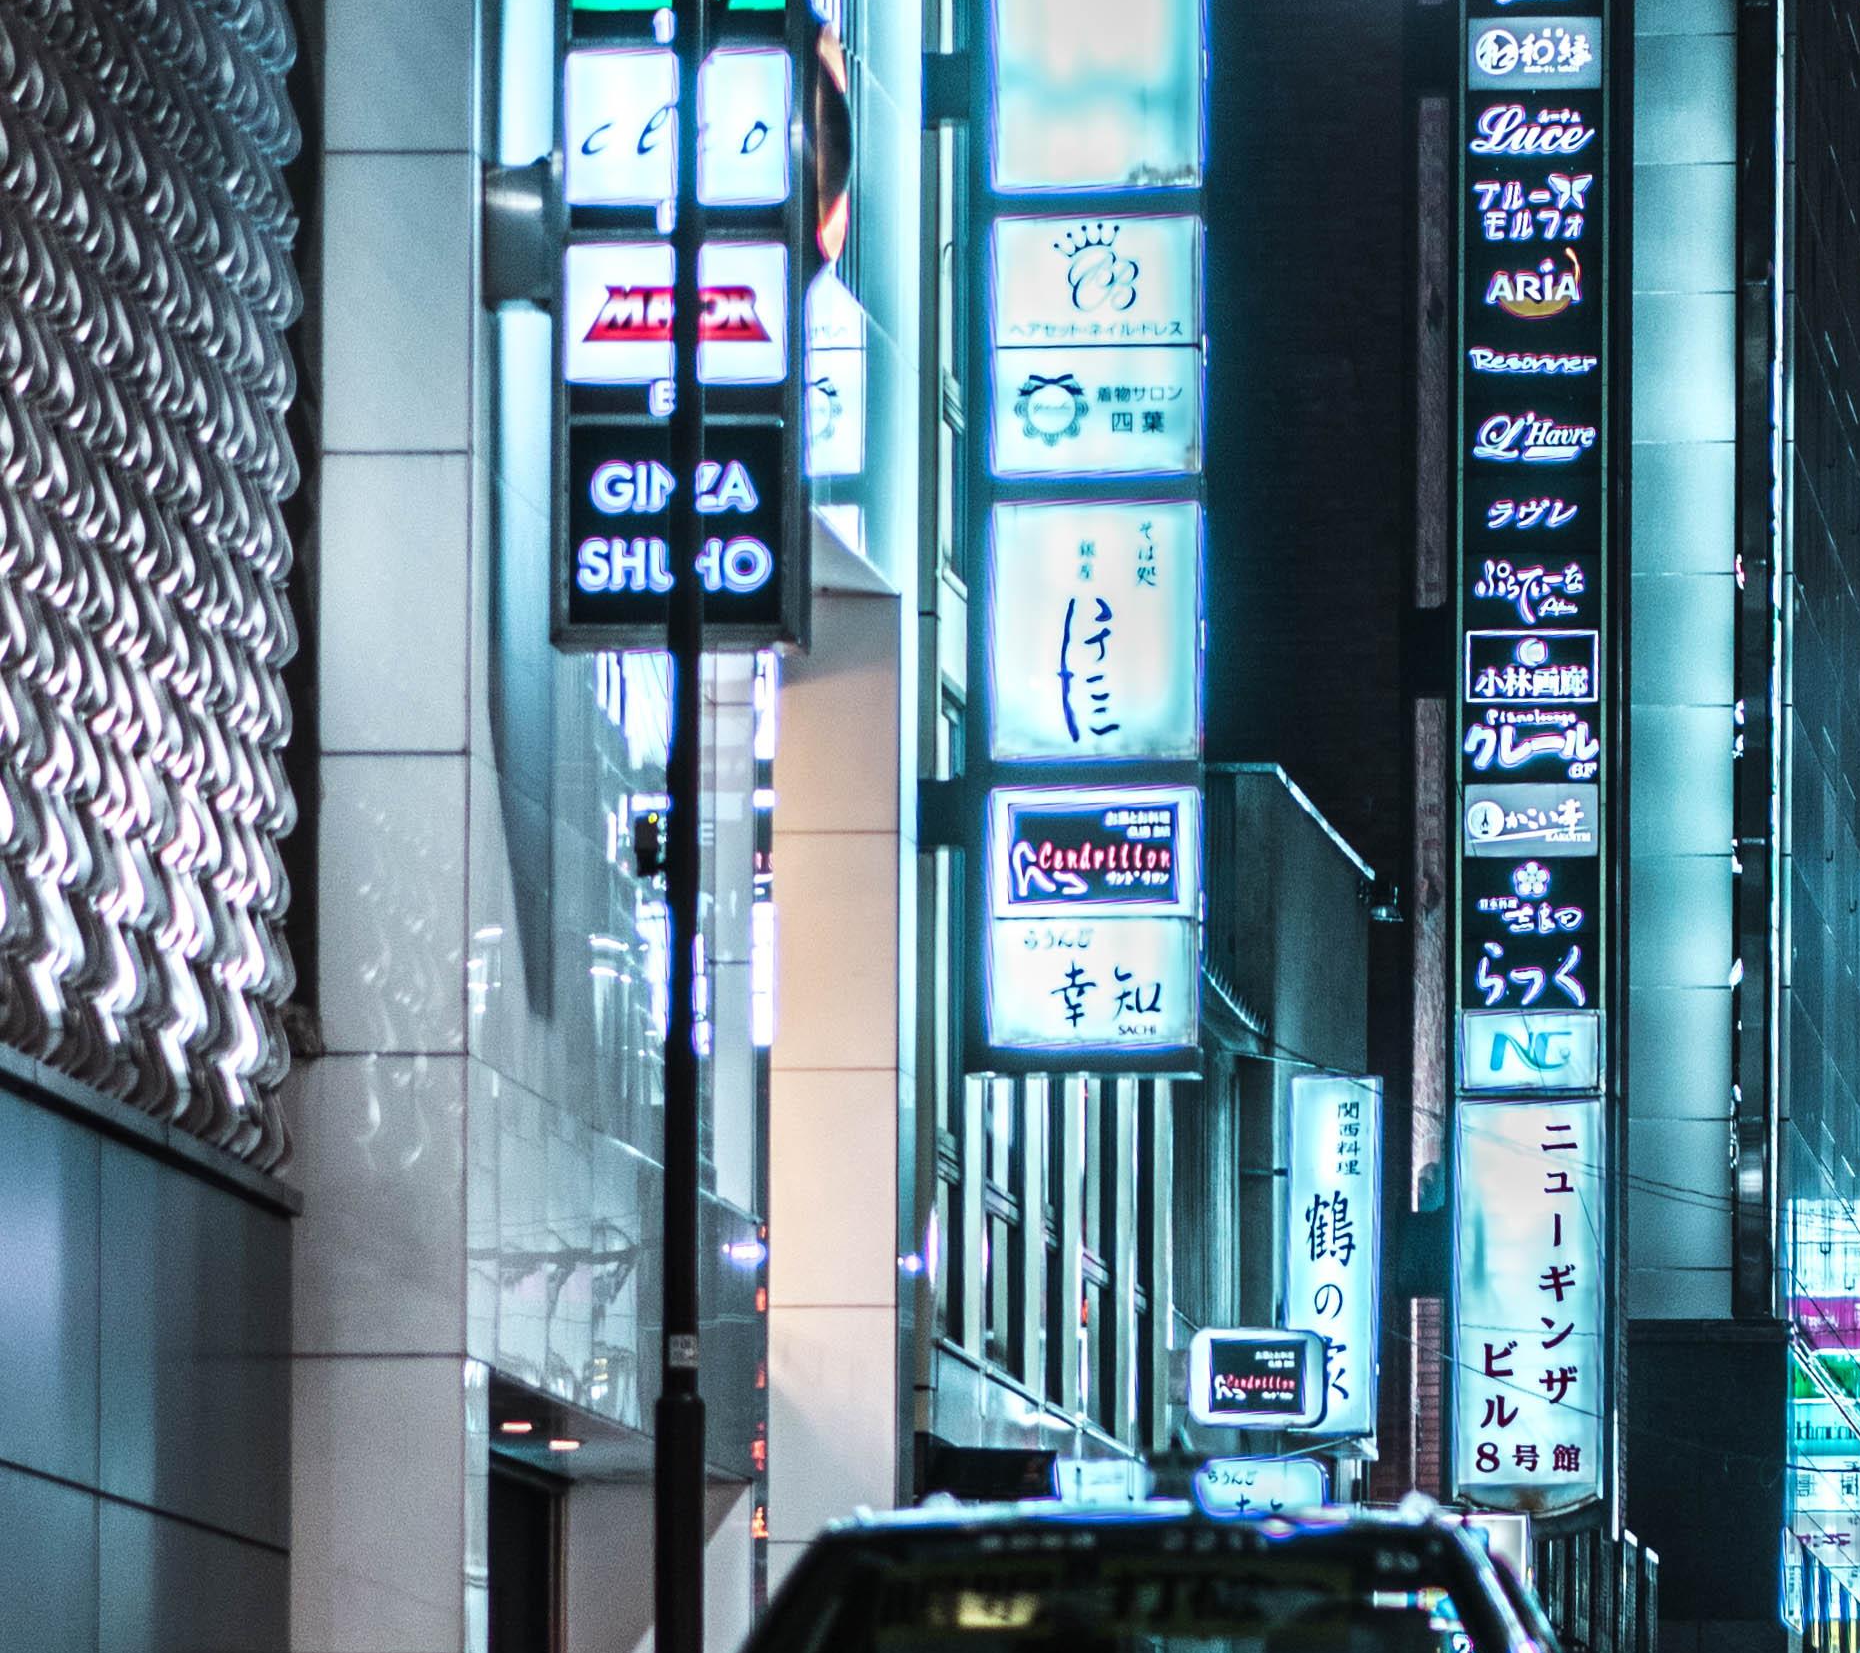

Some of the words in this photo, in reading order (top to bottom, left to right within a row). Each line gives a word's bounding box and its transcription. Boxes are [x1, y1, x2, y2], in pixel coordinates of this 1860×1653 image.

[1464, 722, 1600, 769] クレール
[1336, 1100, 1361, 1177] 関西料理
[1539, 1123, 1579, 1405] ニューギンザ
[1479, 1340, 1519, 1430] ビル
[1475, 1441, 1582, 1474] 8号館
